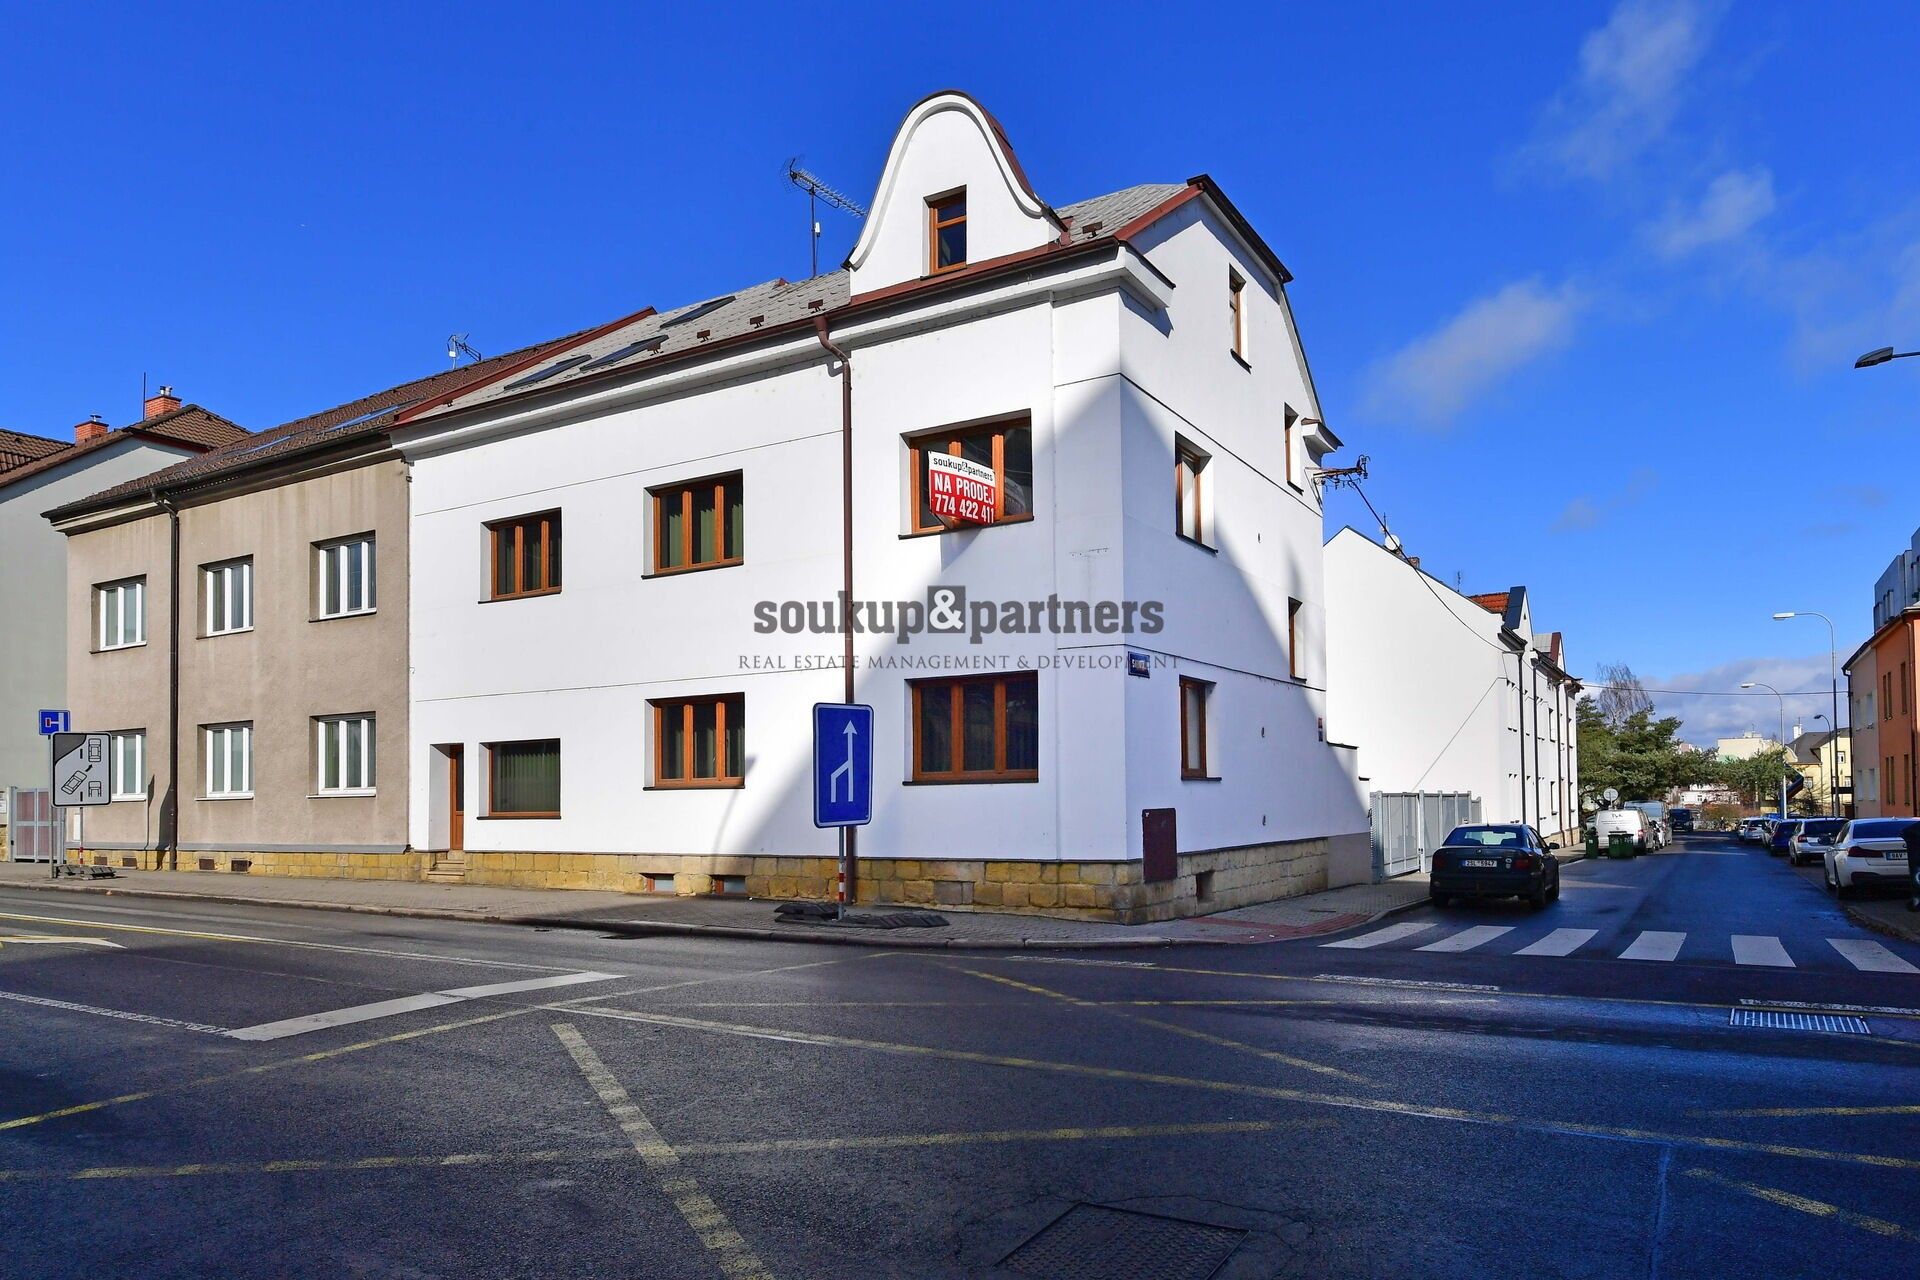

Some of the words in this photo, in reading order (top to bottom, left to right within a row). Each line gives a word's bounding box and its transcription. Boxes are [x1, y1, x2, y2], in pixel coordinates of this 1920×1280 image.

[933, 458, 993, 481] soukup&partners
[934, 472, 952, 494] NA
[956, 478, 994, 505] PRODEJ
[935, 494, 955, 514] 774
[959, 499, 978, 519] 422
[981, 505, 994, 523] 411
